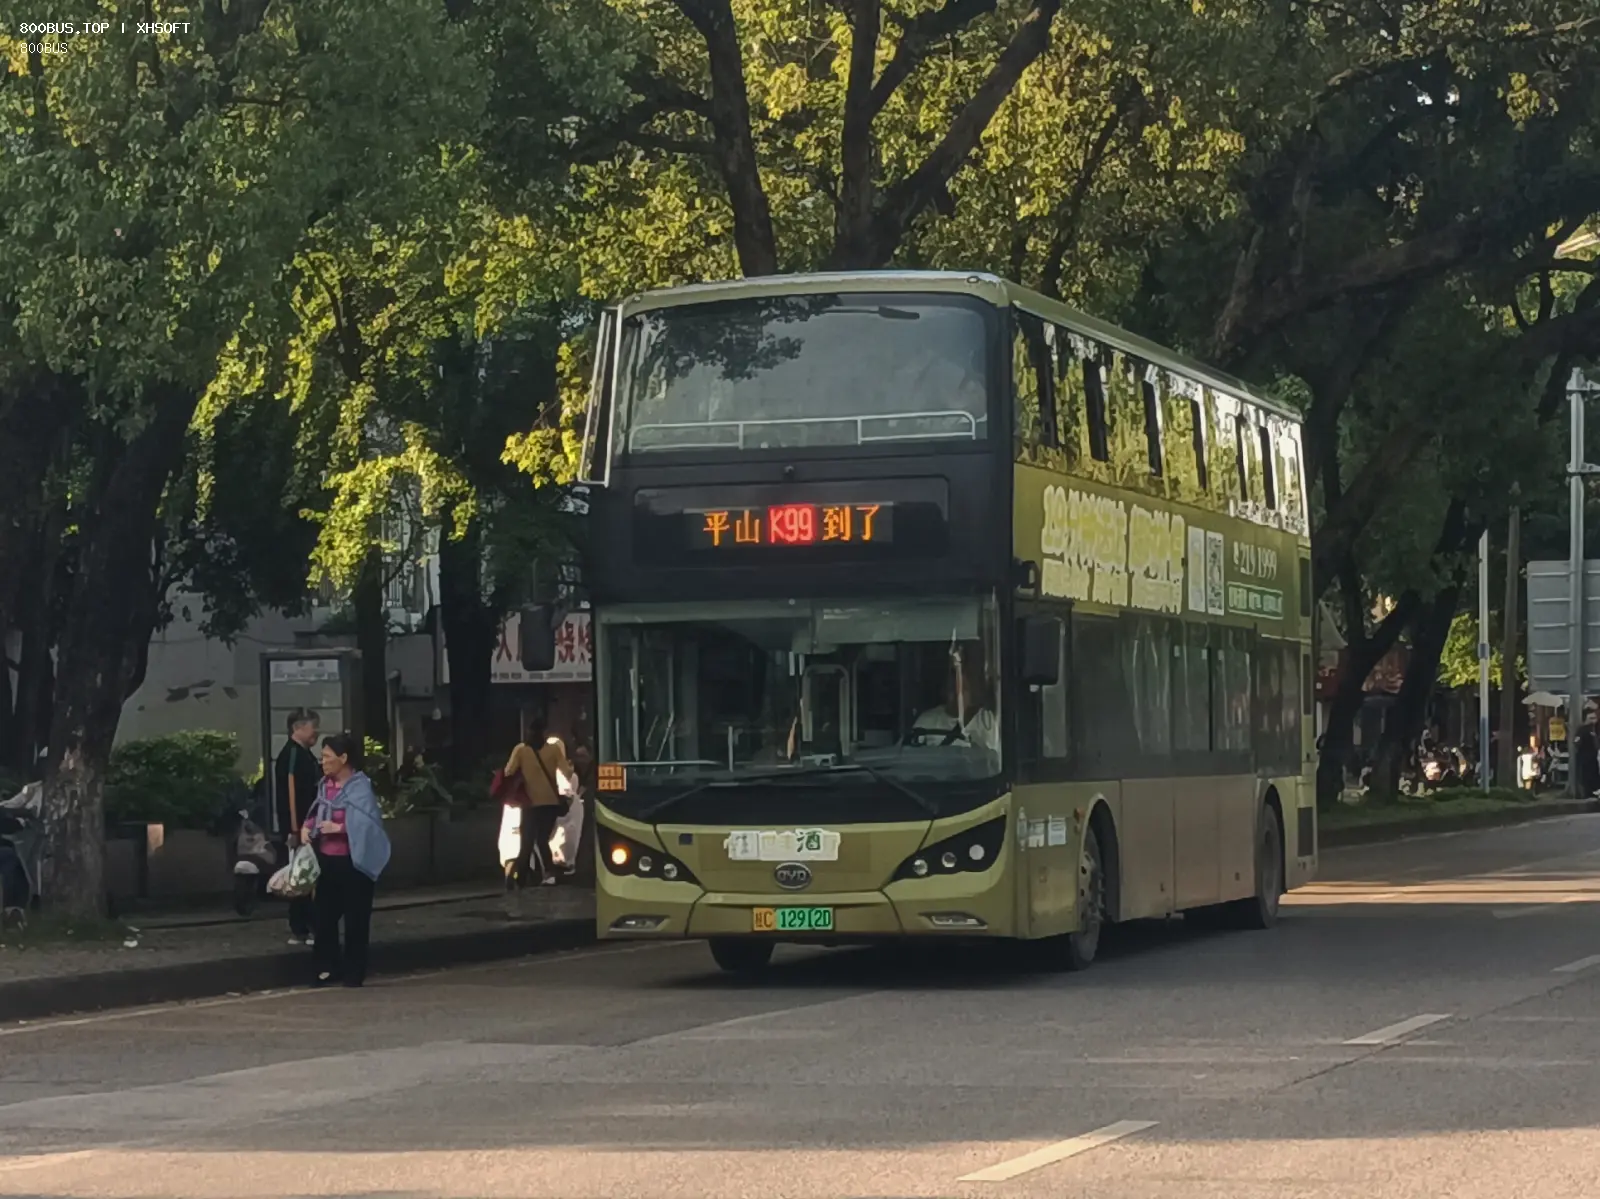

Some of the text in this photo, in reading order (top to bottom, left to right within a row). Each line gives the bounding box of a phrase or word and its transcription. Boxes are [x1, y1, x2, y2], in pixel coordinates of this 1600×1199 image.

[703, 504, 880, 547] 平山 K99 到了
